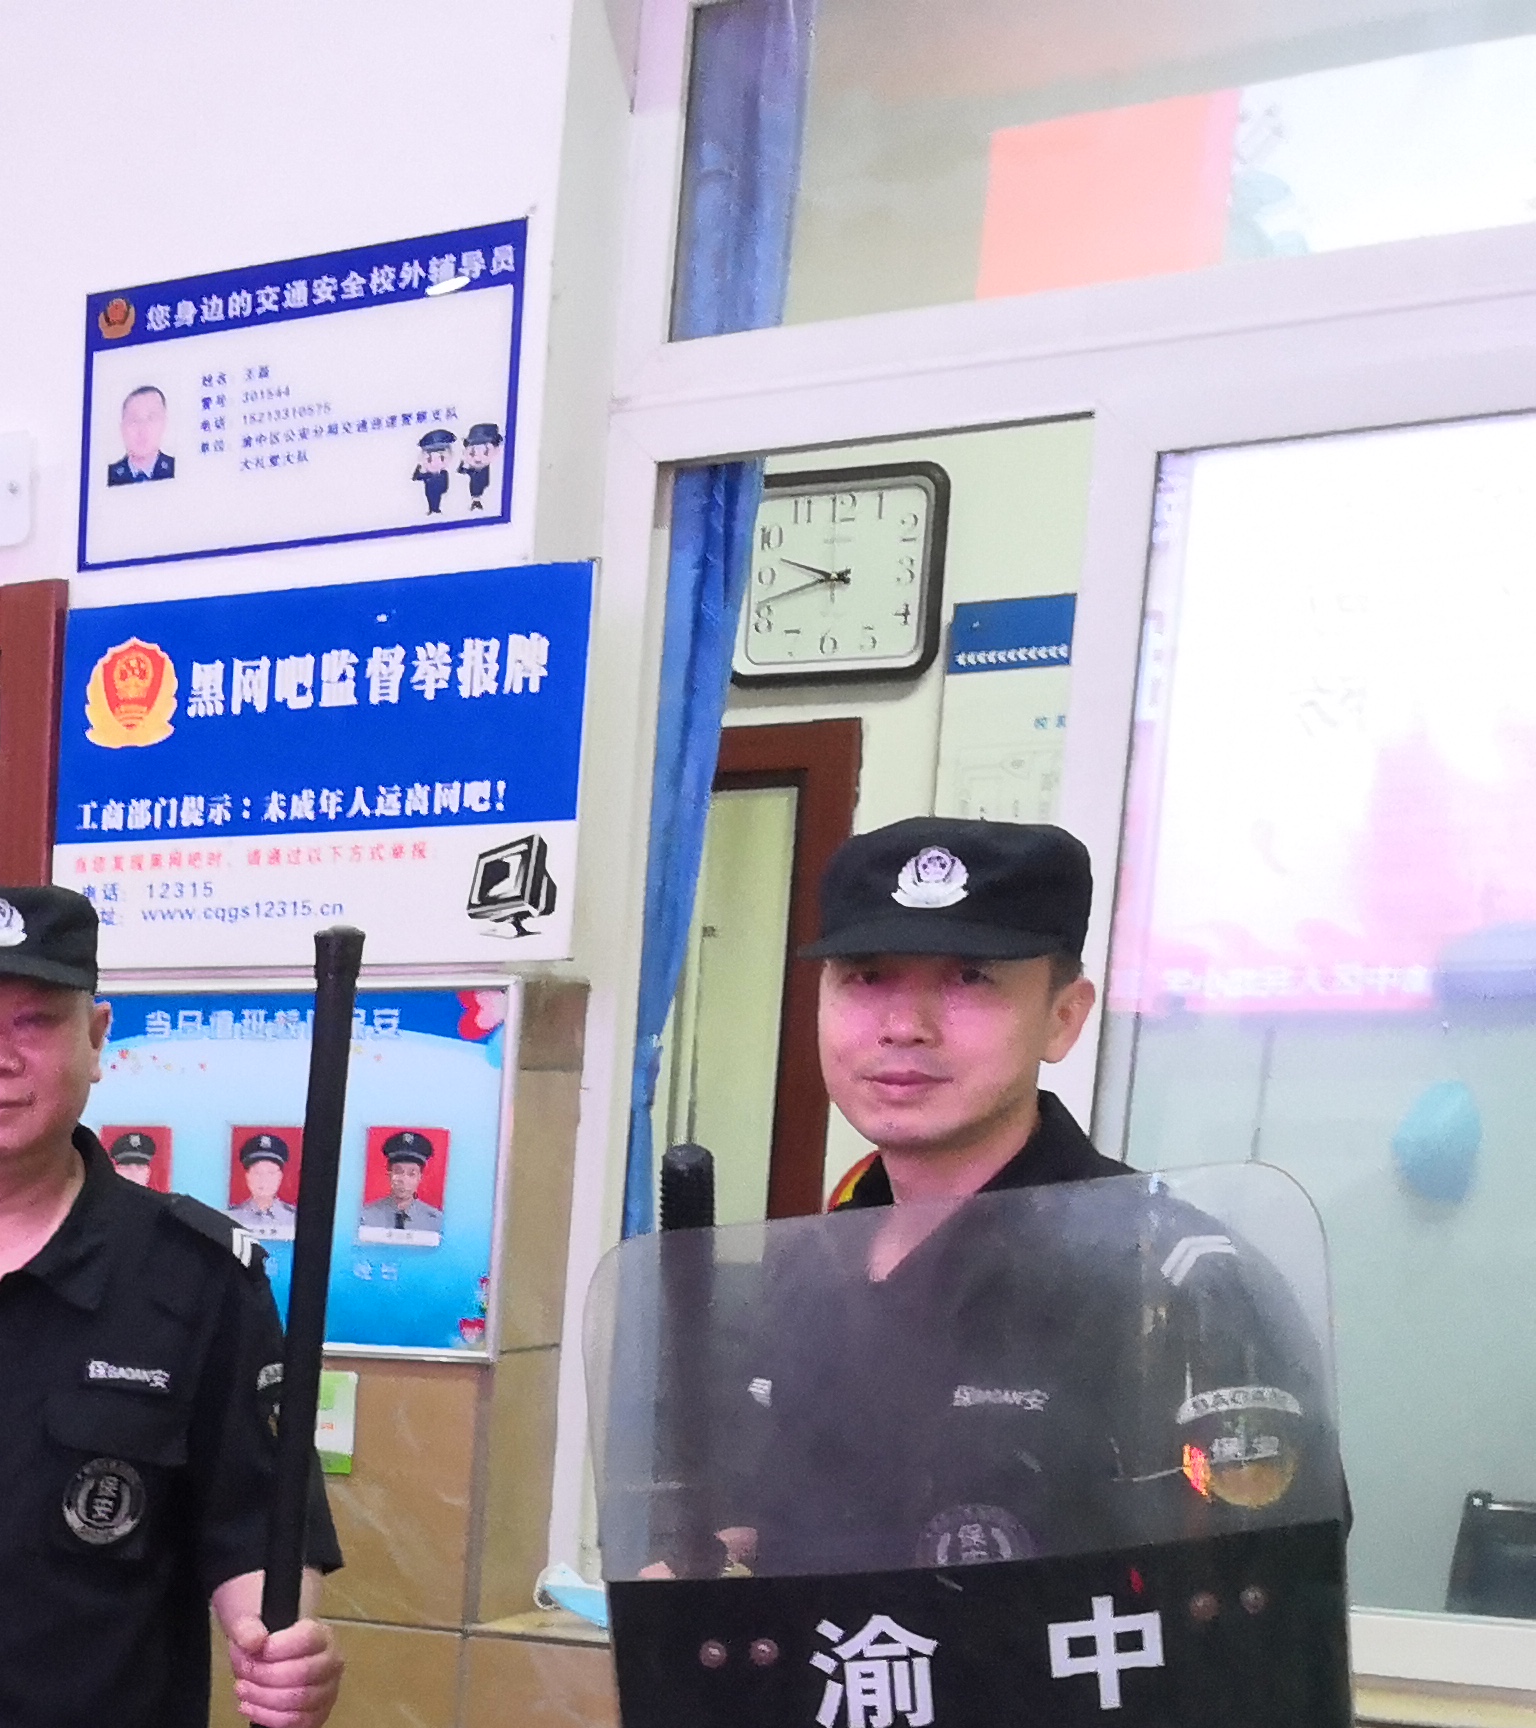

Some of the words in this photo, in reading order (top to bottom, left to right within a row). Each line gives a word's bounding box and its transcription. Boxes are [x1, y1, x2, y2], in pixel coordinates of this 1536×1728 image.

[145, 244, 516, 333] 您身边的交通安全校外辅导员
[794, 499, 812, 524] 11
[831, 493, 857, 522] 12
[760, 525, 783, 551] 10
[900, 513, 918, 542] 2
[898, 556, 915, 584] 3
[754, 604, 773, 634] 8
[891, 603, 911, 626] 4
[819, 629, 837, 655] 6
[186, 632, 551, 718] 黑网吧监督举报牌
[147, 881, 214, 899] 12315
[141, 900, 345, 924] www.cqgs12315.cn
